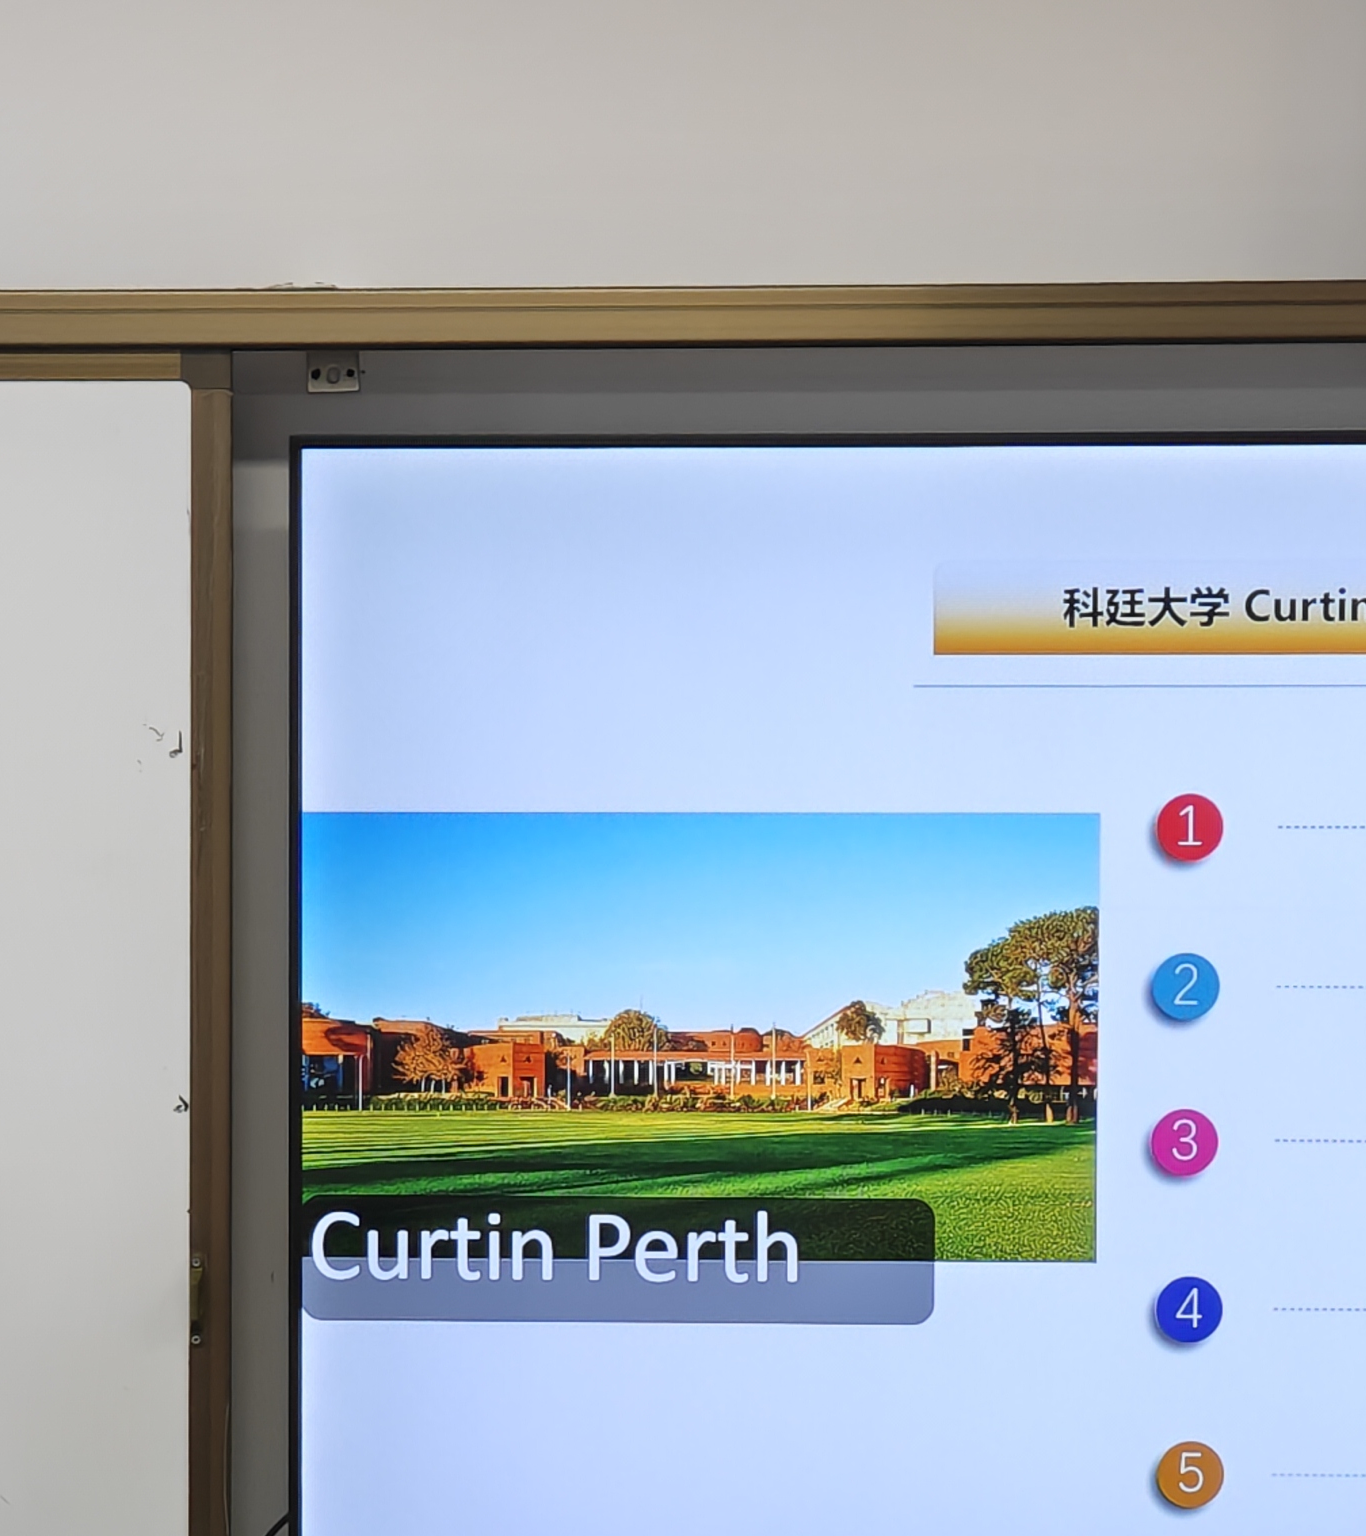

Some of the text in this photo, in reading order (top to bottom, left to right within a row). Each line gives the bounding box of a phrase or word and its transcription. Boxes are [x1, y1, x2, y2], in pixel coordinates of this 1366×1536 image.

[1062, 586, 1231, 629] 科廷大学
[1177, 803, 1202, 847] 1
[1173, 962, 1199, 1007] 2
[1172, 1118, 1198, 1162] 3
[310, 1211, 799, 1284] Curtin Perth
[1175, 1287, 1204, 1330] 4
[1178, 1451, 1204, 1494] 5
